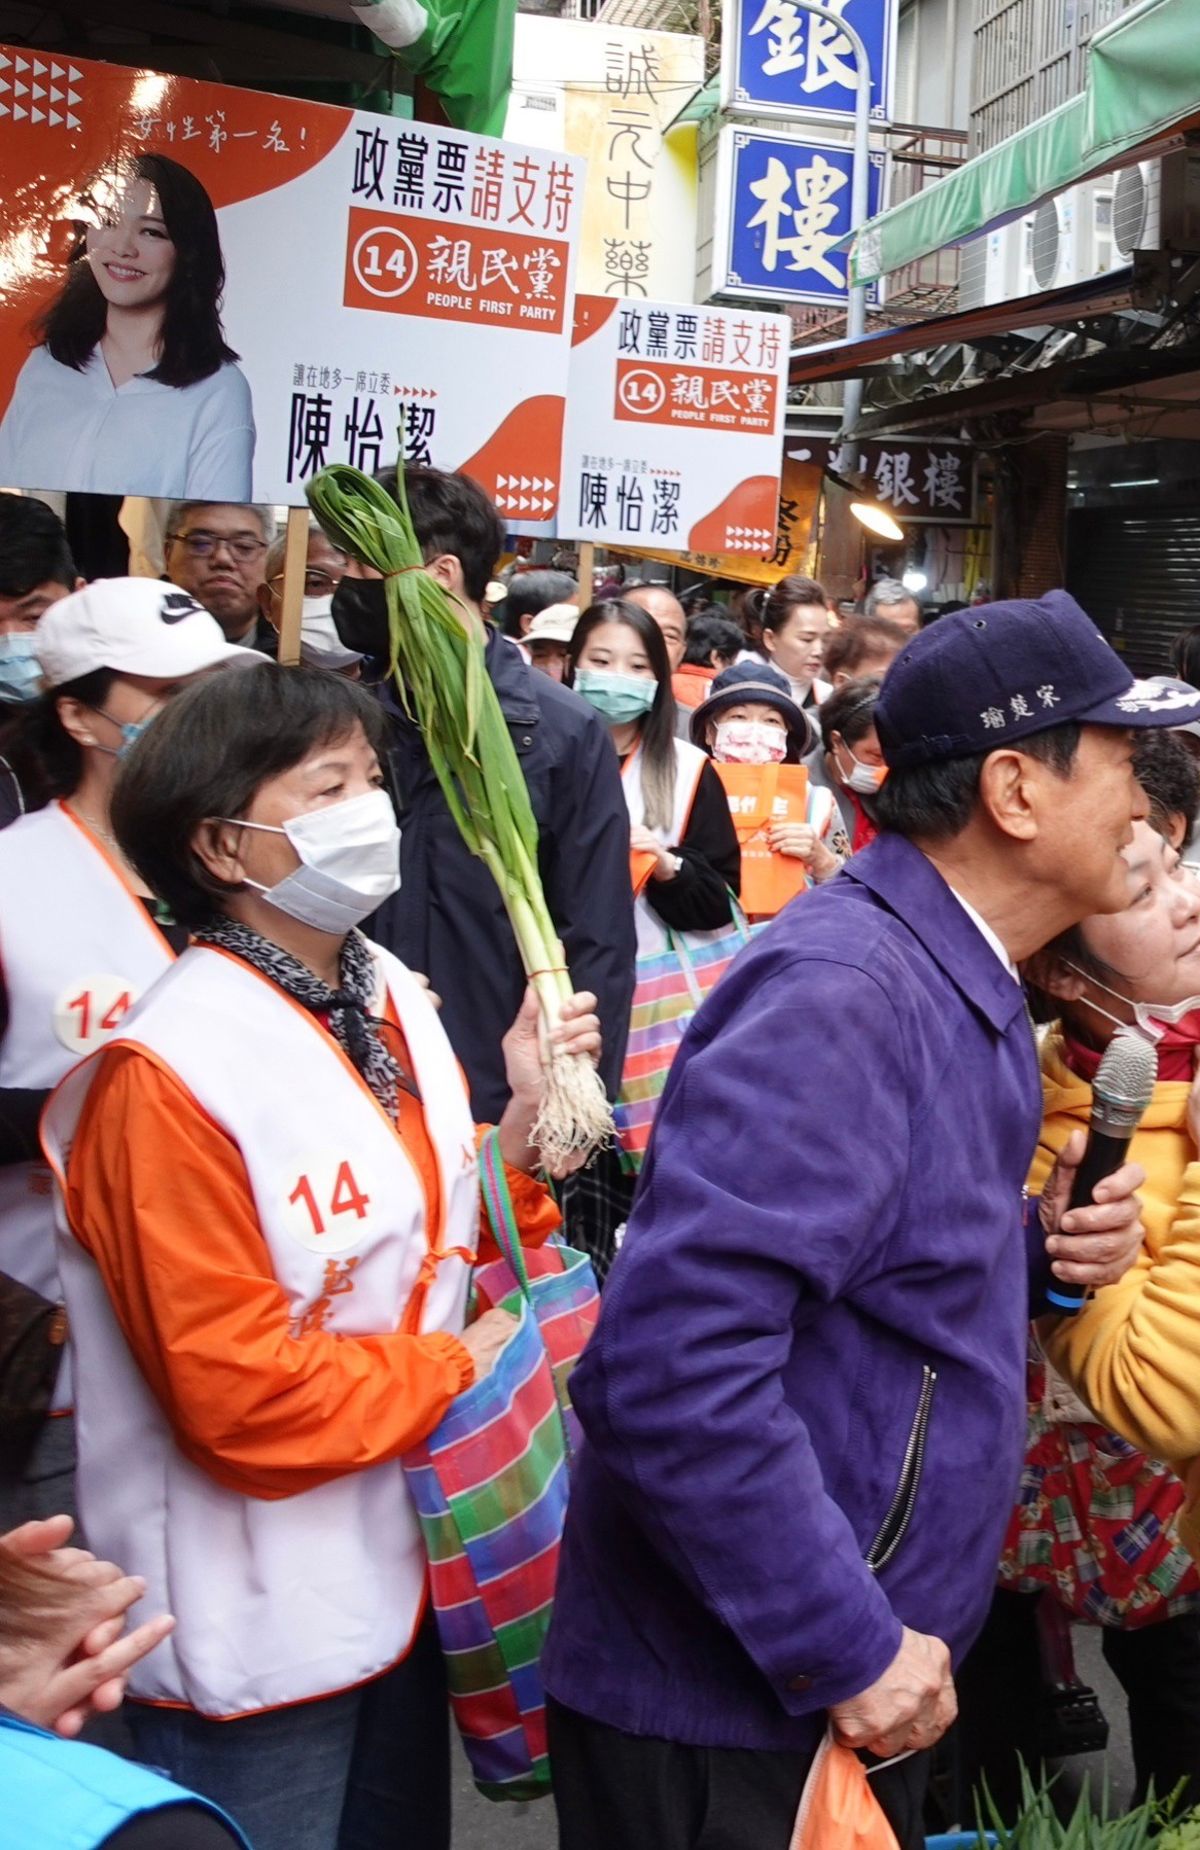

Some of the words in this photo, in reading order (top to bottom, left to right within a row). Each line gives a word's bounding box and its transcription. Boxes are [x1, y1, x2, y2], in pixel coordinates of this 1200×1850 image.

[352, 127, 574, 233] 政黨票請支持
[364, 246, 407, 279] 14
[426, 235, 562, 301] 親民黨
[427, 292, 472, 311] PEOPLE
[479, 299, 512, 315] FIRST
[519, 305, 556, 321] PARTY
[618, 308, 780, 369] 政黨票請支持
[626, 381, 658, 403] 14
[670, 373, 773, 414] 親民黨
[671, 409, 705, 422] PEOPLE
[710, 413, 736, 424] FIRST
[740, 415, 769, 427] PARTY
[286, 393, 436, 484] 陳怡潔
[579, 472, 681, 535] 陳怡潔
[288, 1159, 370, 1236] 14
